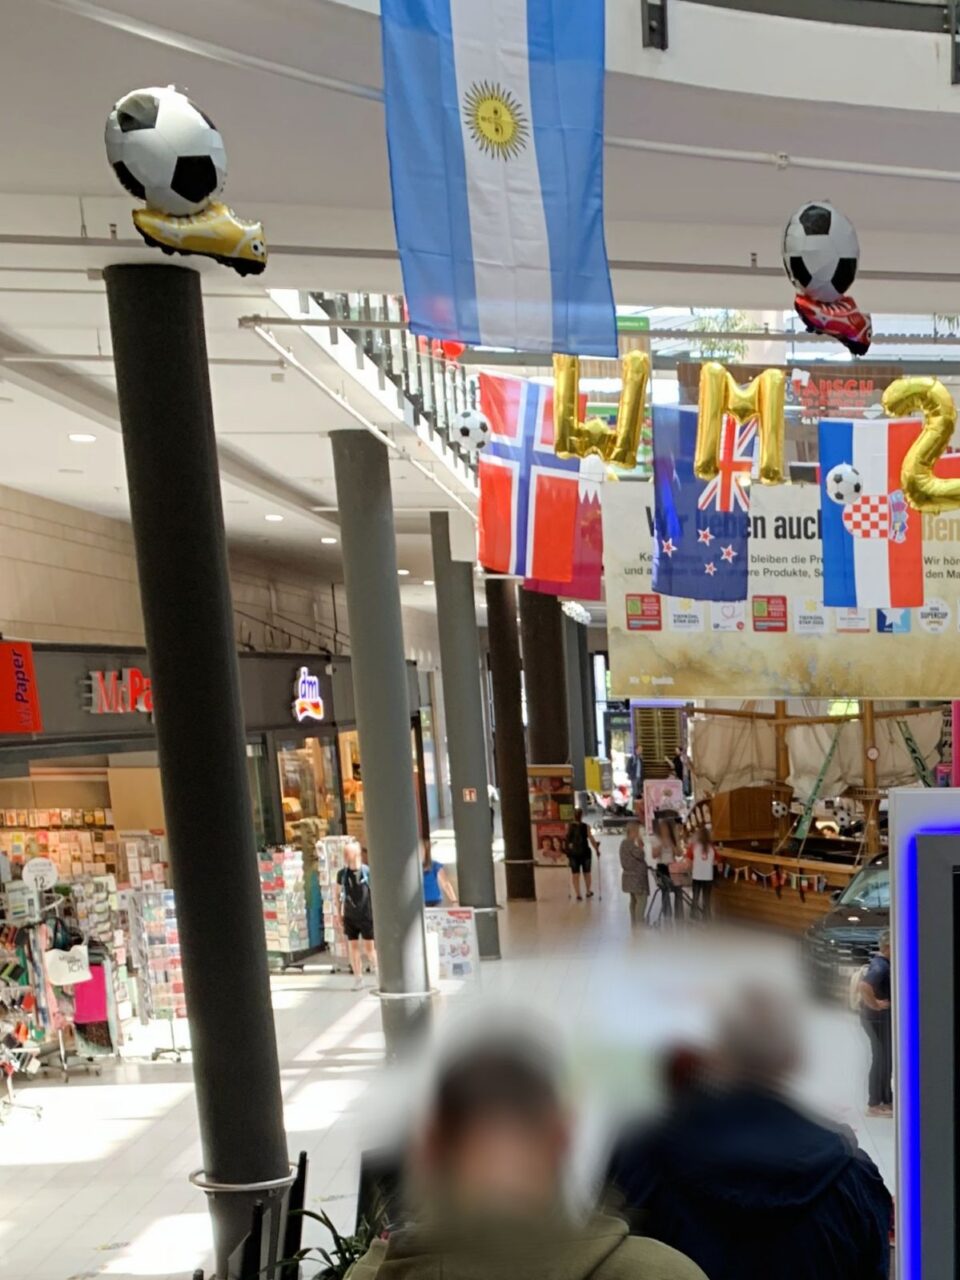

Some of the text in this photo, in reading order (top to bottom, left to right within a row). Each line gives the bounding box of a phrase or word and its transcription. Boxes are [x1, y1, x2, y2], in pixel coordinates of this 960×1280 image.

[751, 554, 787, 564] bleiben
[791, 554, 806, 564] die
[924, 556, 940, 566] Wir
[624, 566, 644, 575] und
[763, 568, 812, 578] Produkte,
[925, 569, 943, 579] den
[91, 667, 155, 715] McPa
[299, 667, 319, 699] dm
